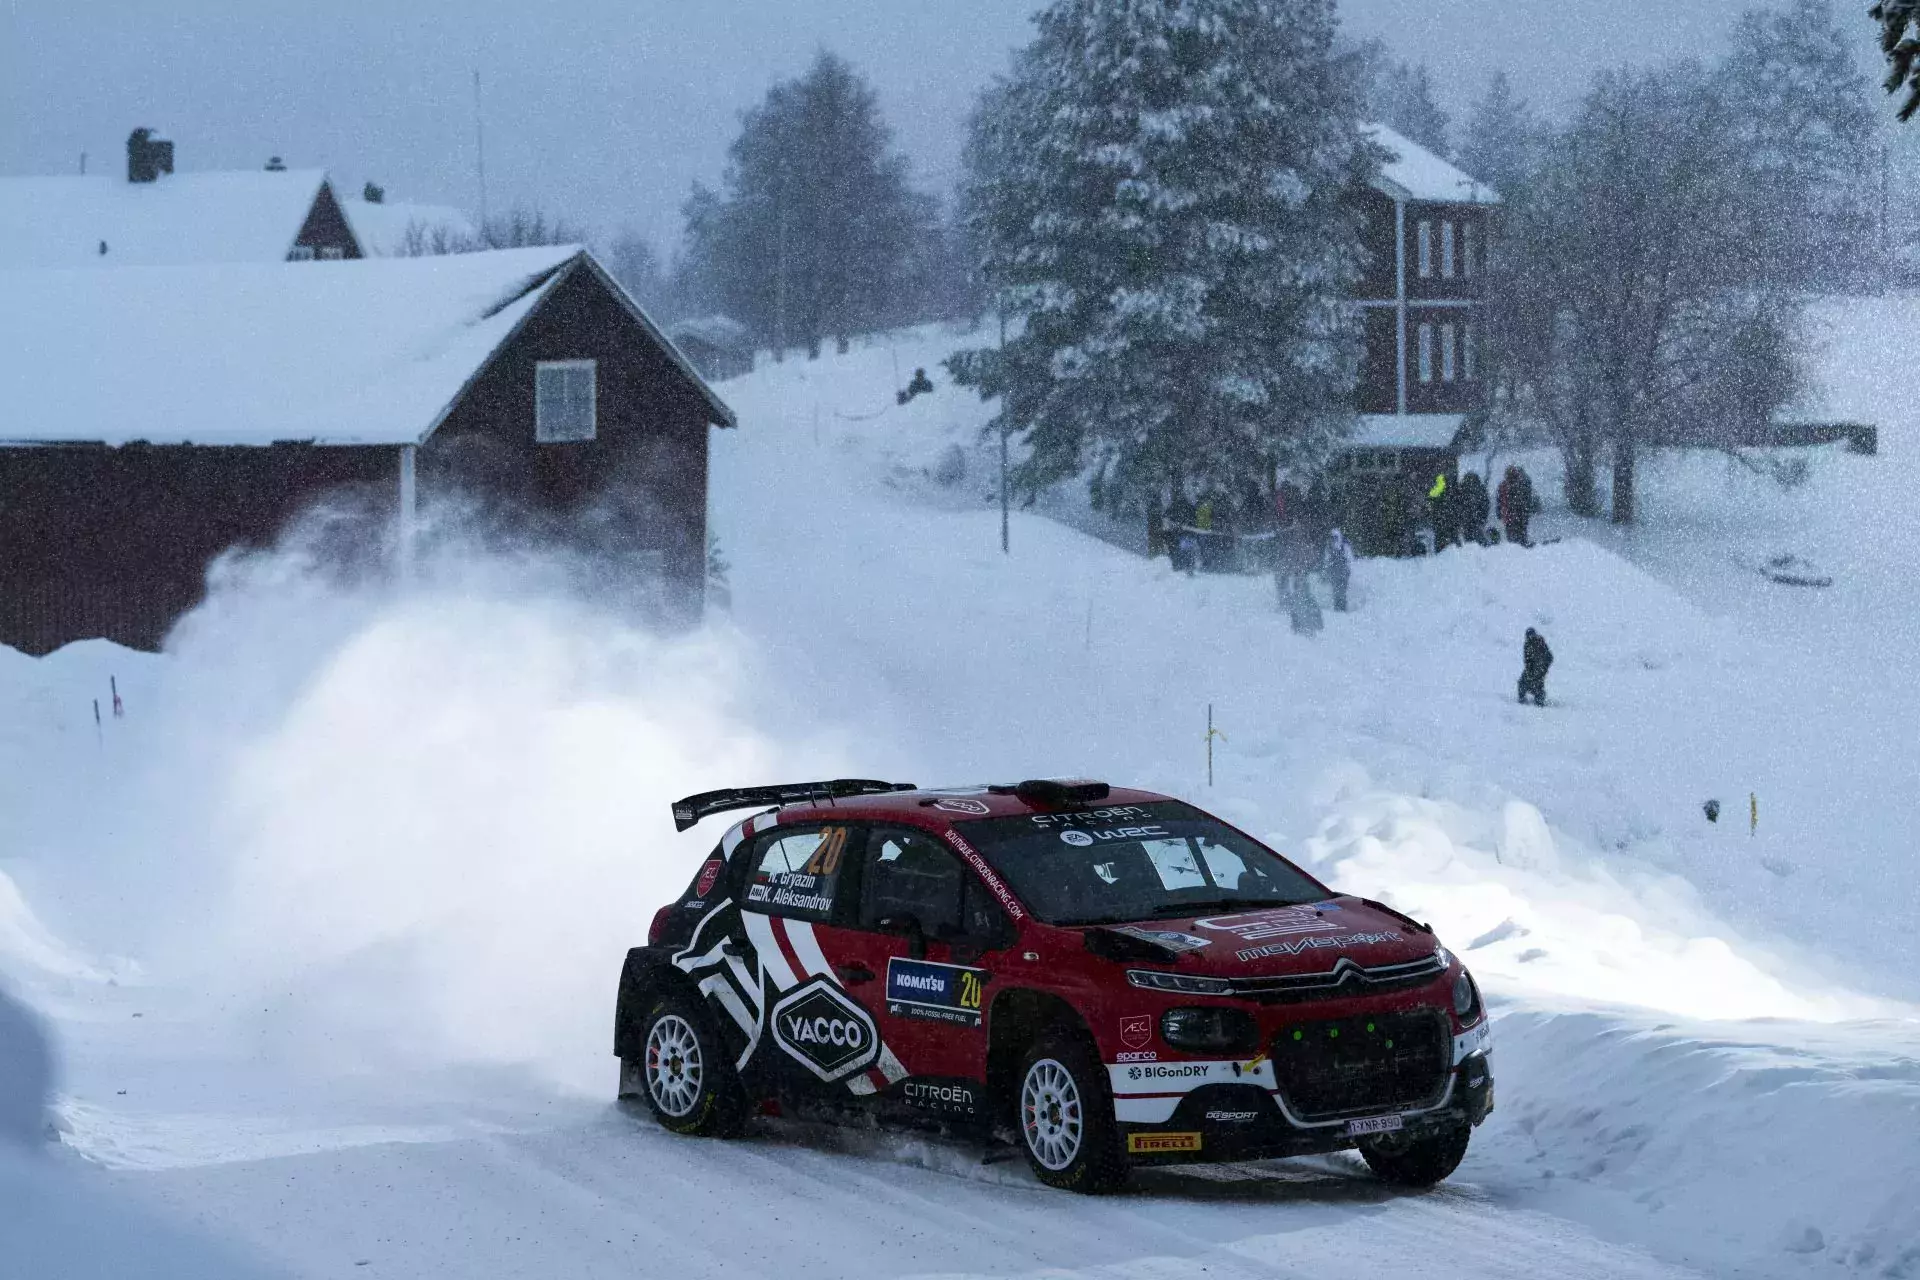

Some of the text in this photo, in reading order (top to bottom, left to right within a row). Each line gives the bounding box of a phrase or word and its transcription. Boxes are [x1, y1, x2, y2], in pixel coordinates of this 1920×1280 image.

[1093, 825, 1169, 840] WRC
[807, 826, 847, 875] 20
[780, 871, 816, 889] Gryazin
[761, 886, 773, 902] K.
[772, 887, 833, 911] Aleksandrov
[896, 974, 945, 992] KOMATSU
[786, 1015, 862, 1049] YACCO
[1116, 1051, 1157, 1062] sparco
[1144, 1065, 1209, 1078] BIGonDRY
[1134, 1135, 1194, 1149] PIRELLI
